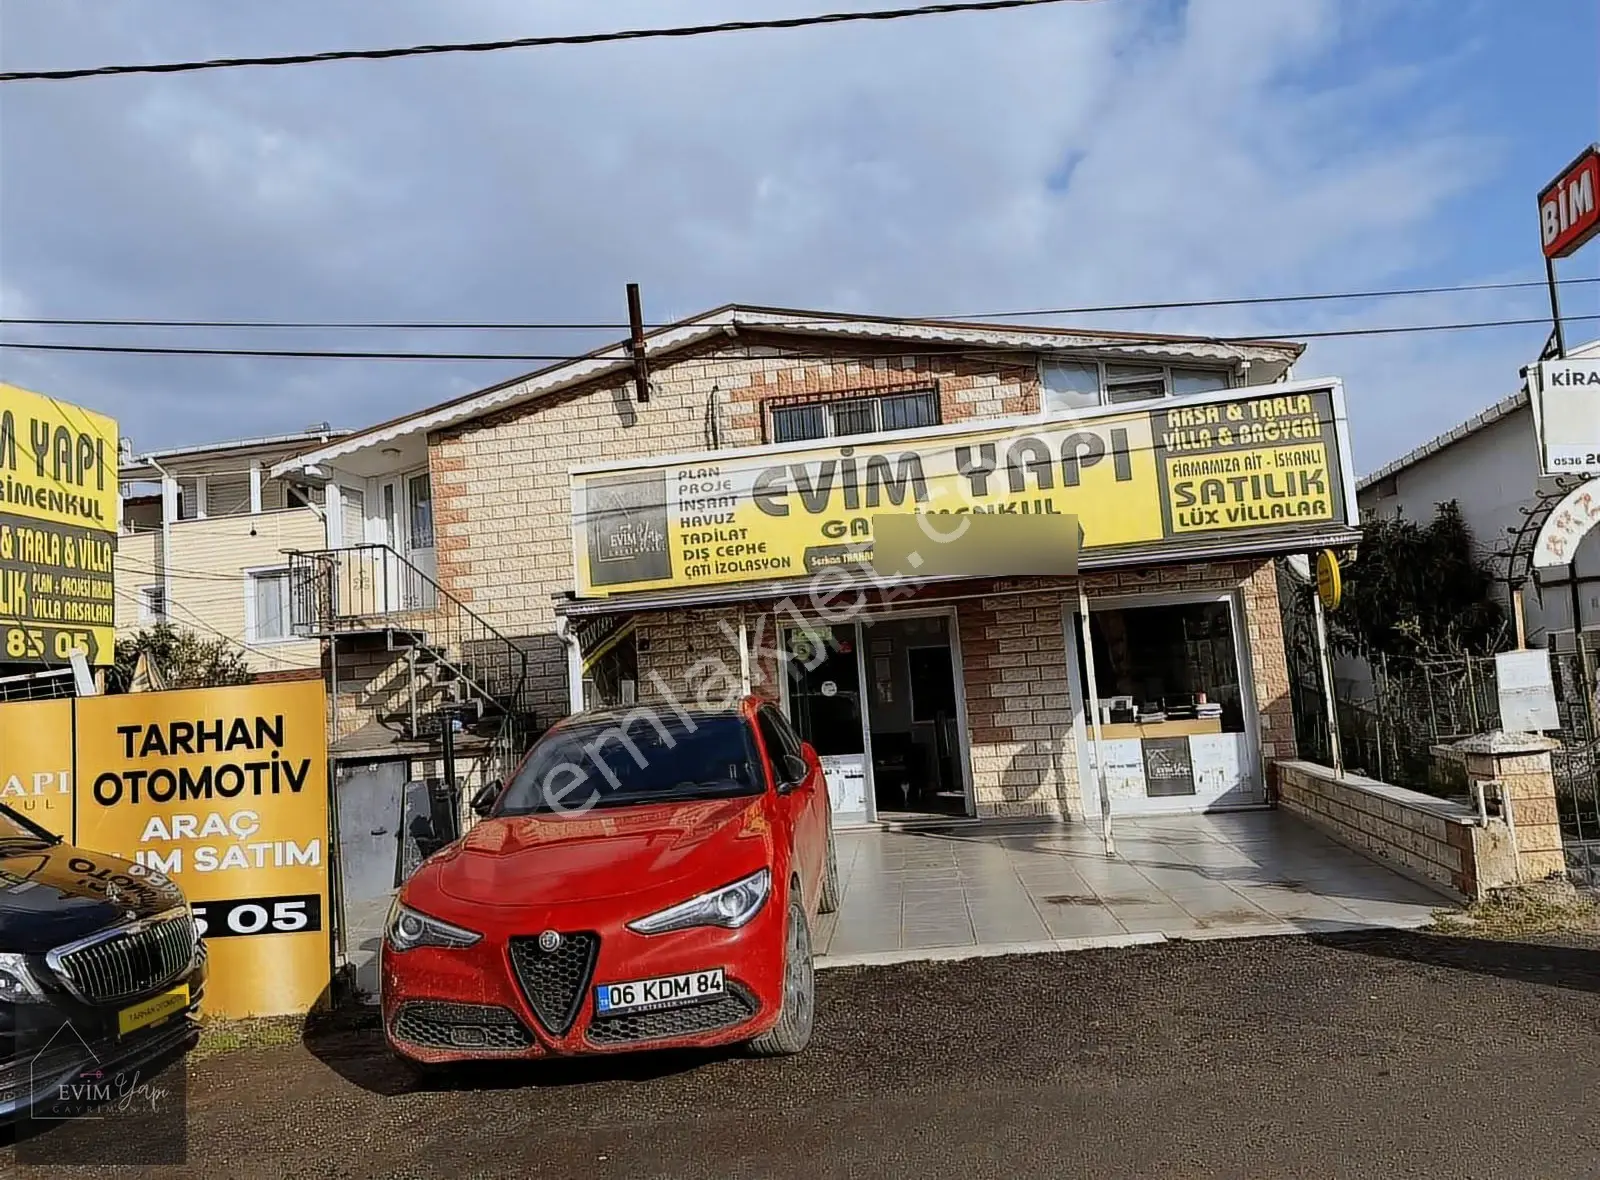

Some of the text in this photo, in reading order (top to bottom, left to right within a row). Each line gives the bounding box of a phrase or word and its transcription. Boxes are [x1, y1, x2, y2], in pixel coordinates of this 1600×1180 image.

[1542, 170, 1594, 246] BİM
[1552, 369, 1600, 386] KİRA
[1167, 394, 1312, 428] ARSA & TARLA
[30, 418, 104, 491] YAPI
[1163, 428, 1212, 452] VİLLA
[1218, 427, 1235, 446] &
[678, 467, 720, 481] PLAN
[752, 428, 1132, 517] EVİM YAPI
[1172, 457, 1241, 478] FİRMAMIZA
[1244, 451, 1262, 471] AİT
[1274, 449, 1321, 468] İSKANLI
[679, 480, 731, 495] PROJE
[1174, 469, 1325, 508] SATILIK
[679, 496, 738, 513] İNŞAAT
[1179, 500, 1327, 527] LÜX VİLLALAR
[681, 513, 735, 529] HAVUZ
[1, 525, 112, 573] & TARLA & VİLLA
[681, 528, 748, 546] TADİLAT
[684, 542, 767, 562] DIŞ CEPHE
[32, 572, 52, 593] PLAN
[685, 557, 791, 580] ÇATI İZOLASYON
[32, 594, 113, 623] VİLLA ARSALARI
[6, 628, 89, 659] 85 05
[117, 715, 283, 759] TARHAN
[93, 750, 311, 807] OTOMOTİV
[140, 810, 260, 841] ARAÇ
[194, 839, 321, 873] SATIM
[227, 901, 308, 934] 05
[610, 986, 635, 1005] 06
[643, 977, 691, 1002] KDM
[697, 972, 722, 993] 84
